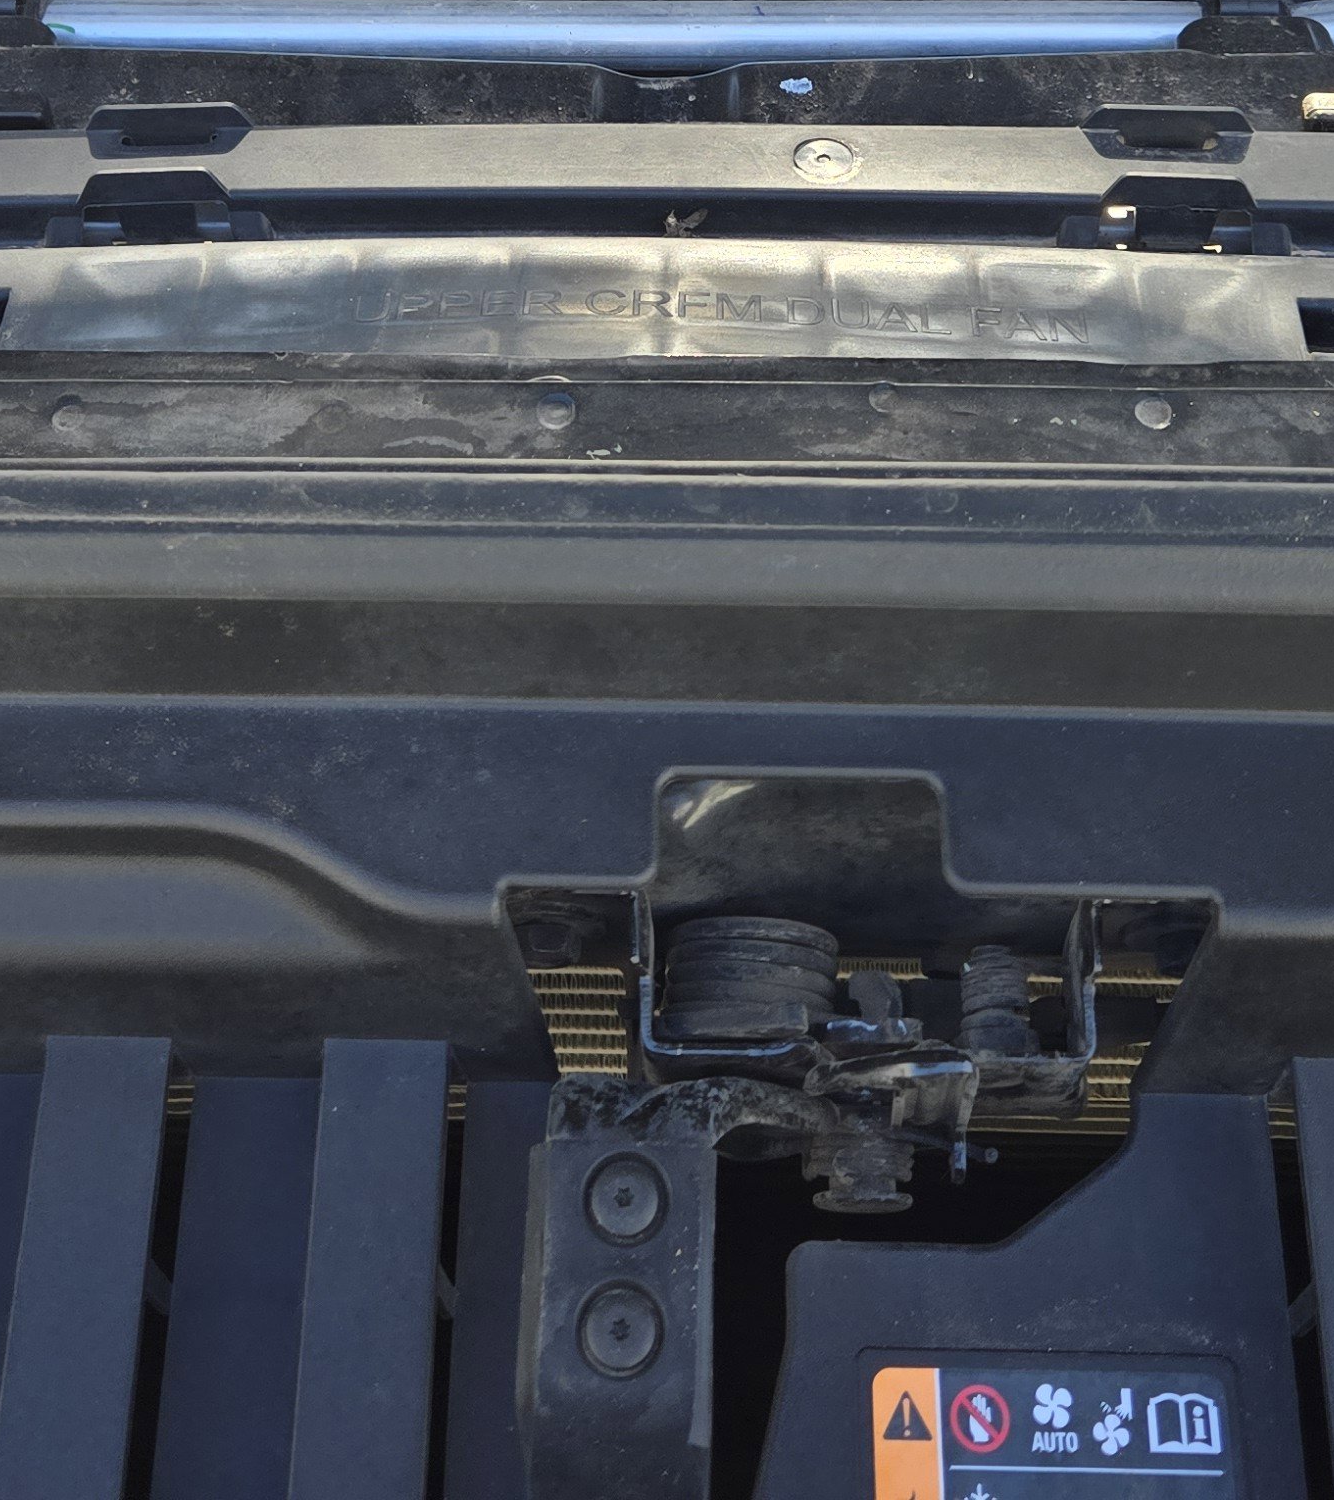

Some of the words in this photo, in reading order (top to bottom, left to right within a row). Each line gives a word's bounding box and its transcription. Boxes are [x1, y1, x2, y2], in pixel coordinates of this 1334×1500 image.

[354, 288, 564, 324] UPPER
[584, 289, 763, 324] CRFM
[784, 295, 953, 335] DUAL
[969, 304, 1091, 345] FAN
[1031, 1430, 1079, 1454] AUTO
